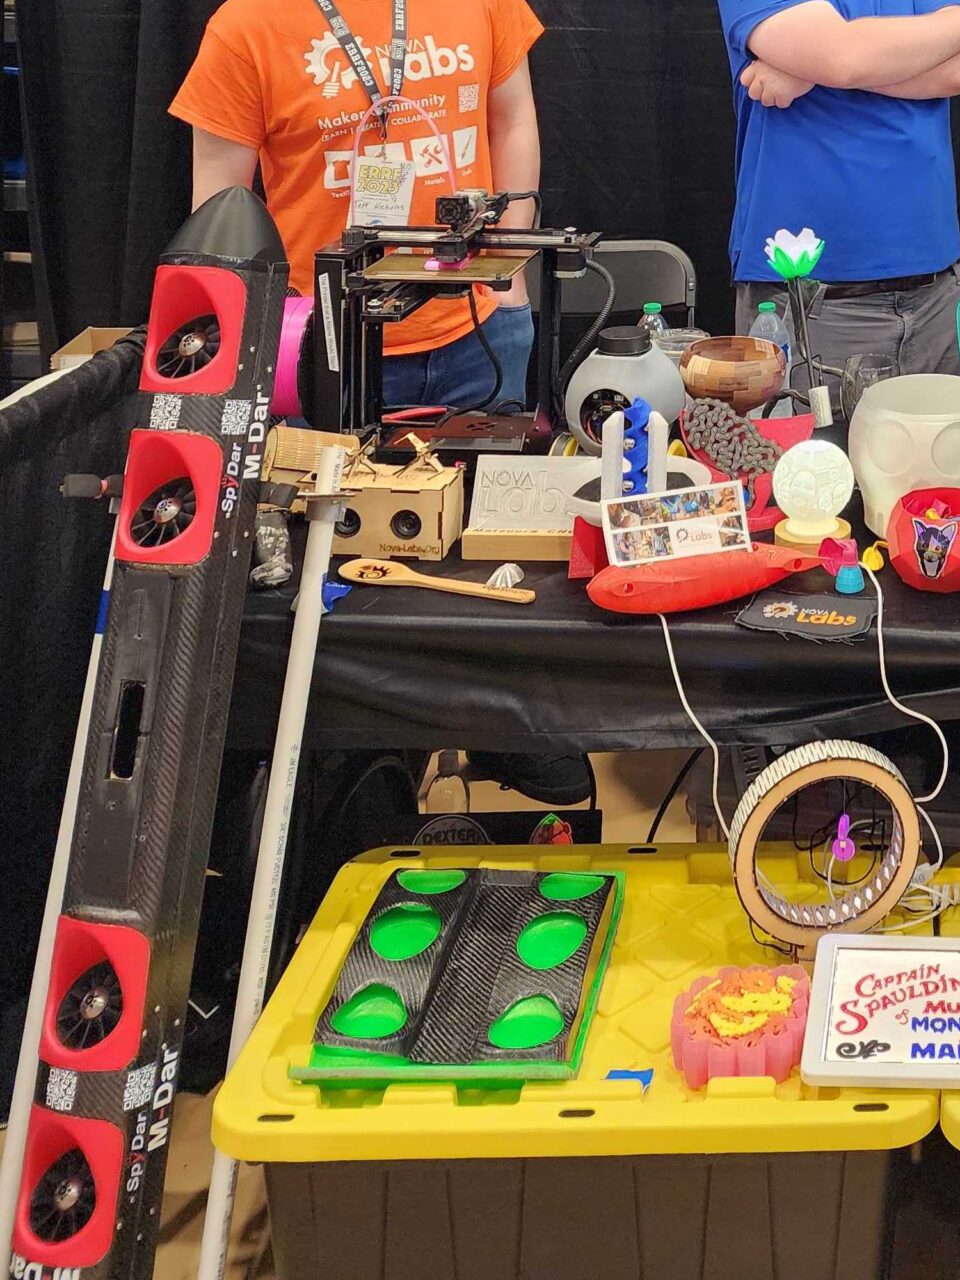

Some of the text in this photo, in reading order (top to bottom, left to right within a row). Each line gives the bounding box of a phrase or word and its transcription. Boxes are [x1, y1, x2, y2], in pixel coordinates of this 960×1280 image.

[345, 42, 374, 87] ERRF2023
[318, 110, 366, 130] Maker
[359, 164, 402, 181] ERRF
[243, 394, 270, 479] M-Dar
[480, 470, 574, 517] Lab
[481, 470, 534, 487] NOVA
[797, 610, 857, 625] Labs
[147, 1049, 180, 1151] M-Dar
[126, 1110, 148, 1192] SpyDar
